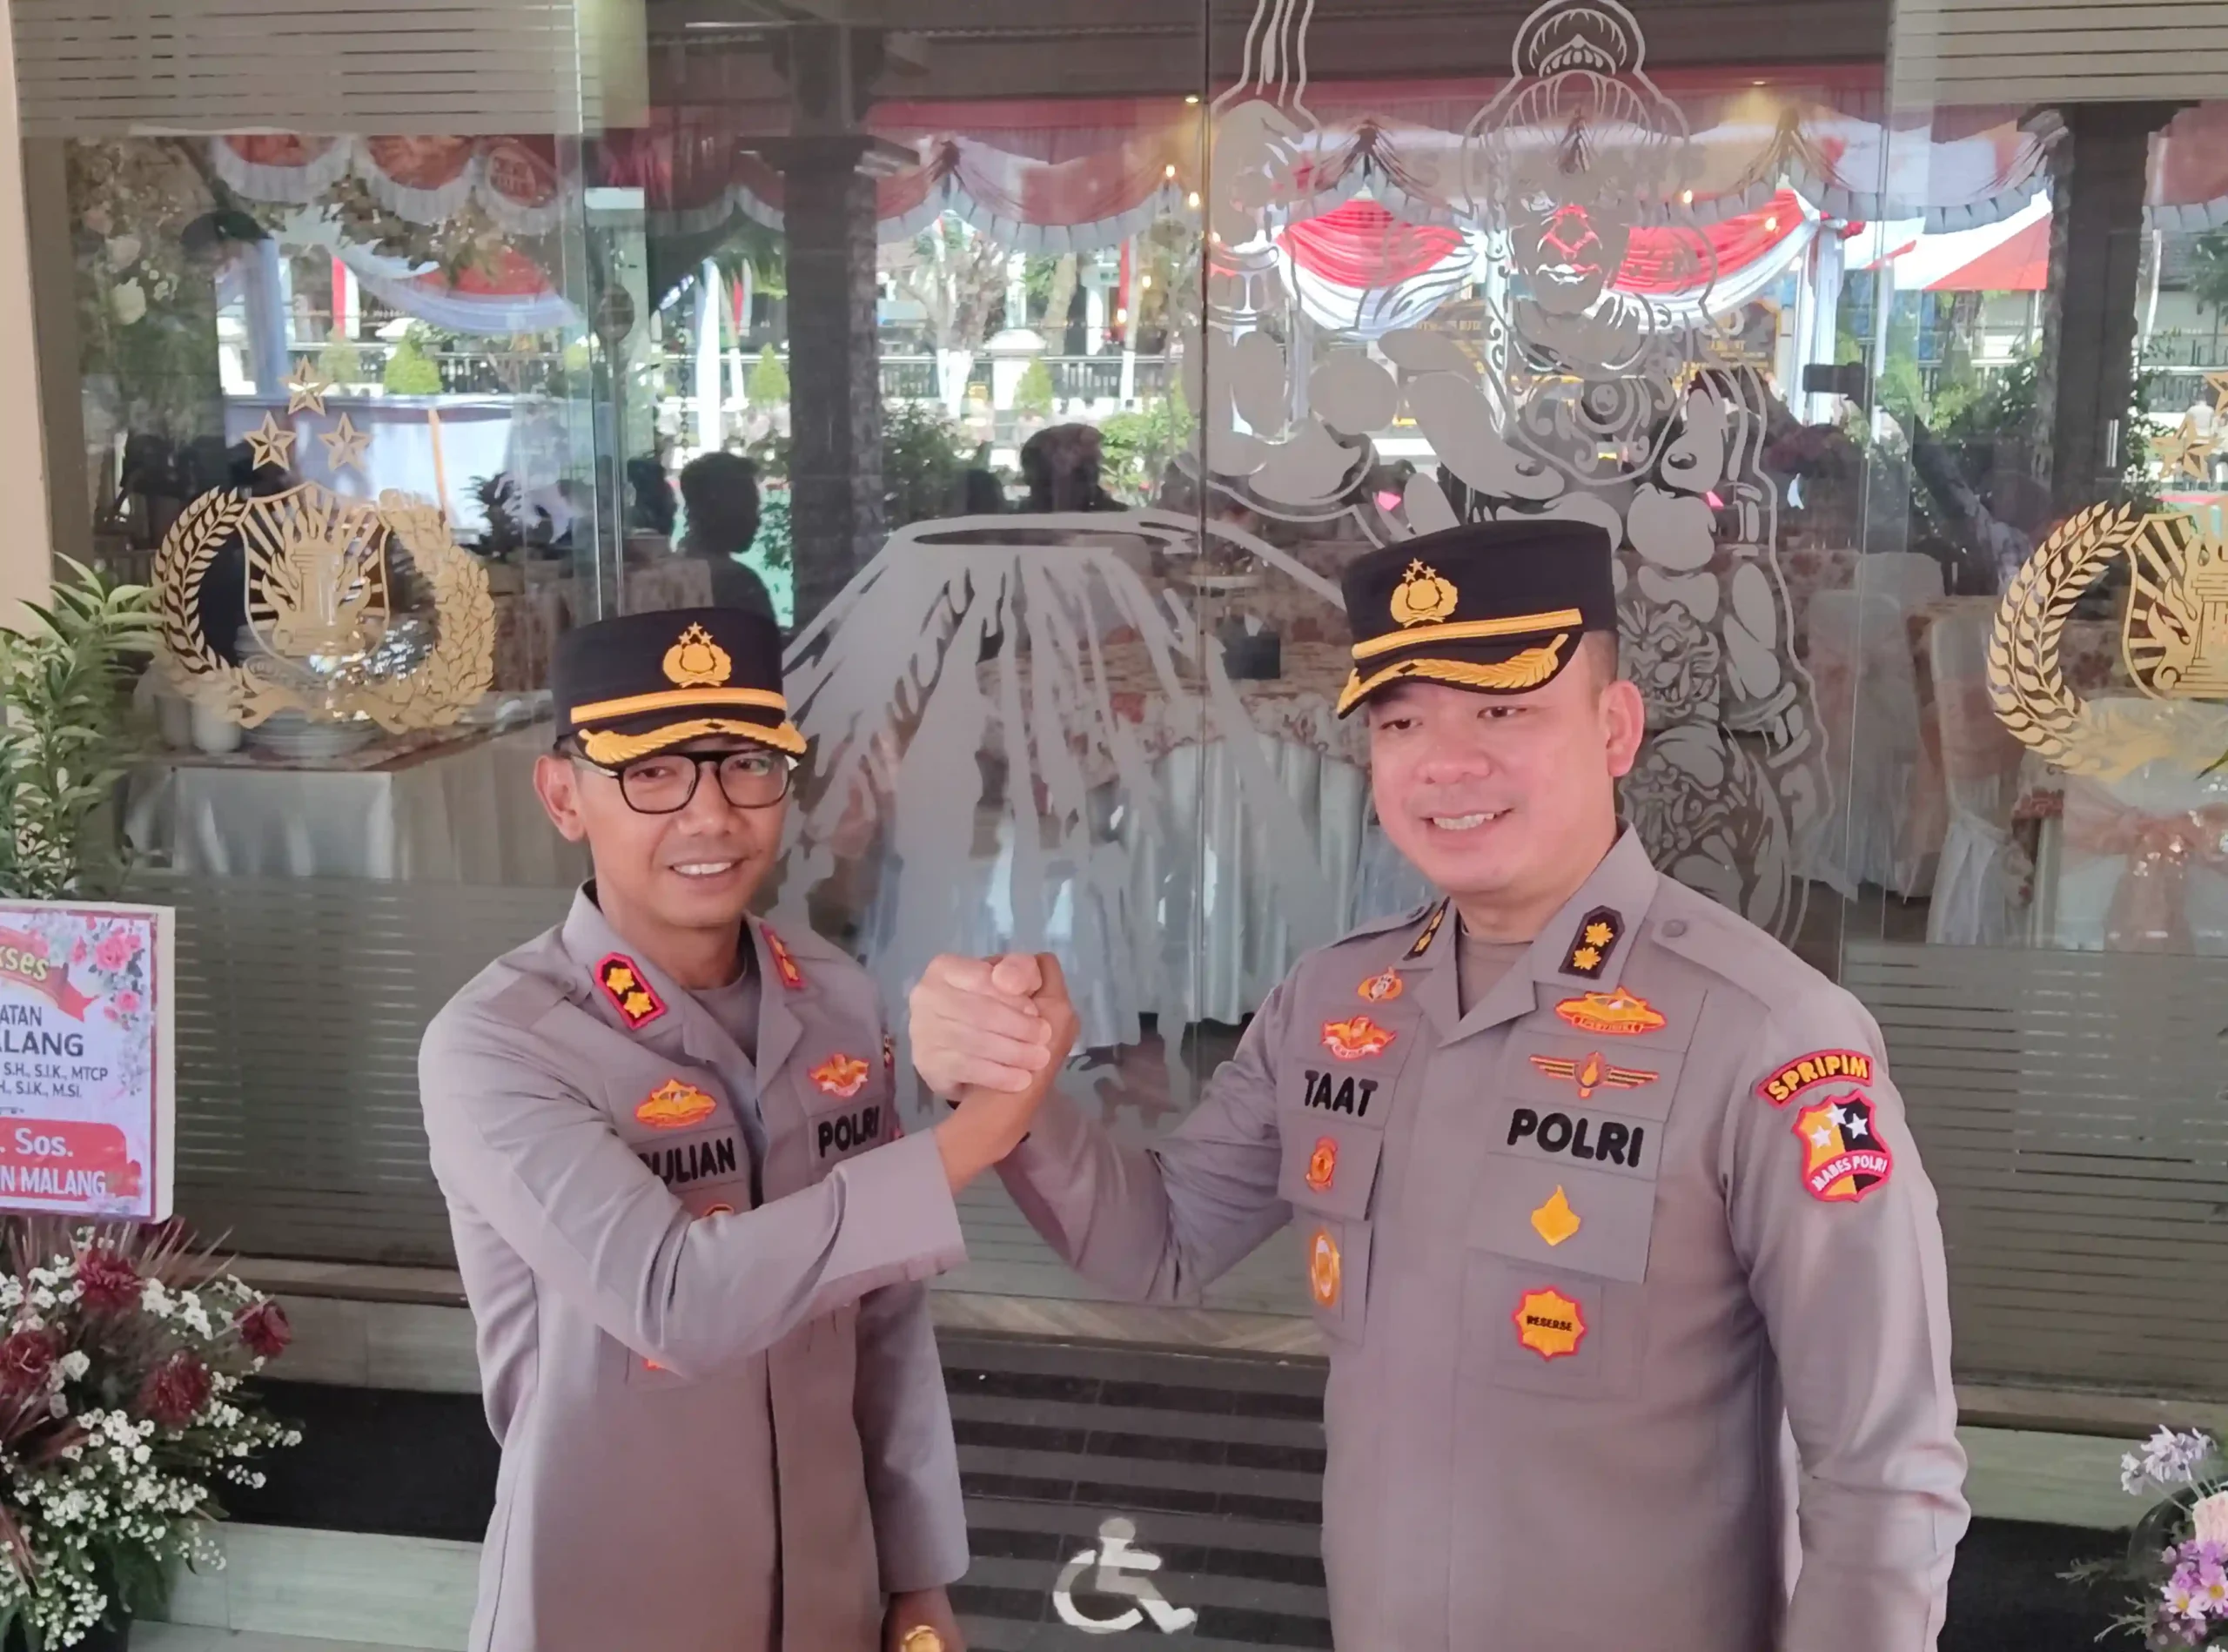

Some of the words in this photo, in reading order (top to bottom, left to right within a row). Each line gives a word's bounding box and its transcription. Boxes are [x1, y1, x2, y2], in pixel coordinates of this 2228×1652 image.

[0, 1029, 84, 1057] LANG
[71, 1065, 109, 1080] MTCP
[1768, 1054, 1868, 1101] SPRIPIM
[1305, 1070, 1379, 1117] TAAT
[15, 1128, 74, 1157] Sos.
[818, 1105, 879, 1158] POLRI
[1507, 1108, 1644, 1168] POLRI
[20, 1166, 106, 1198] MALANG
[1811, 1158, 1852, 1192] MABES
[1852, 1154, 1888, 1173] POLRI
[1527, 1315, 1573, 1332] RESERSE
